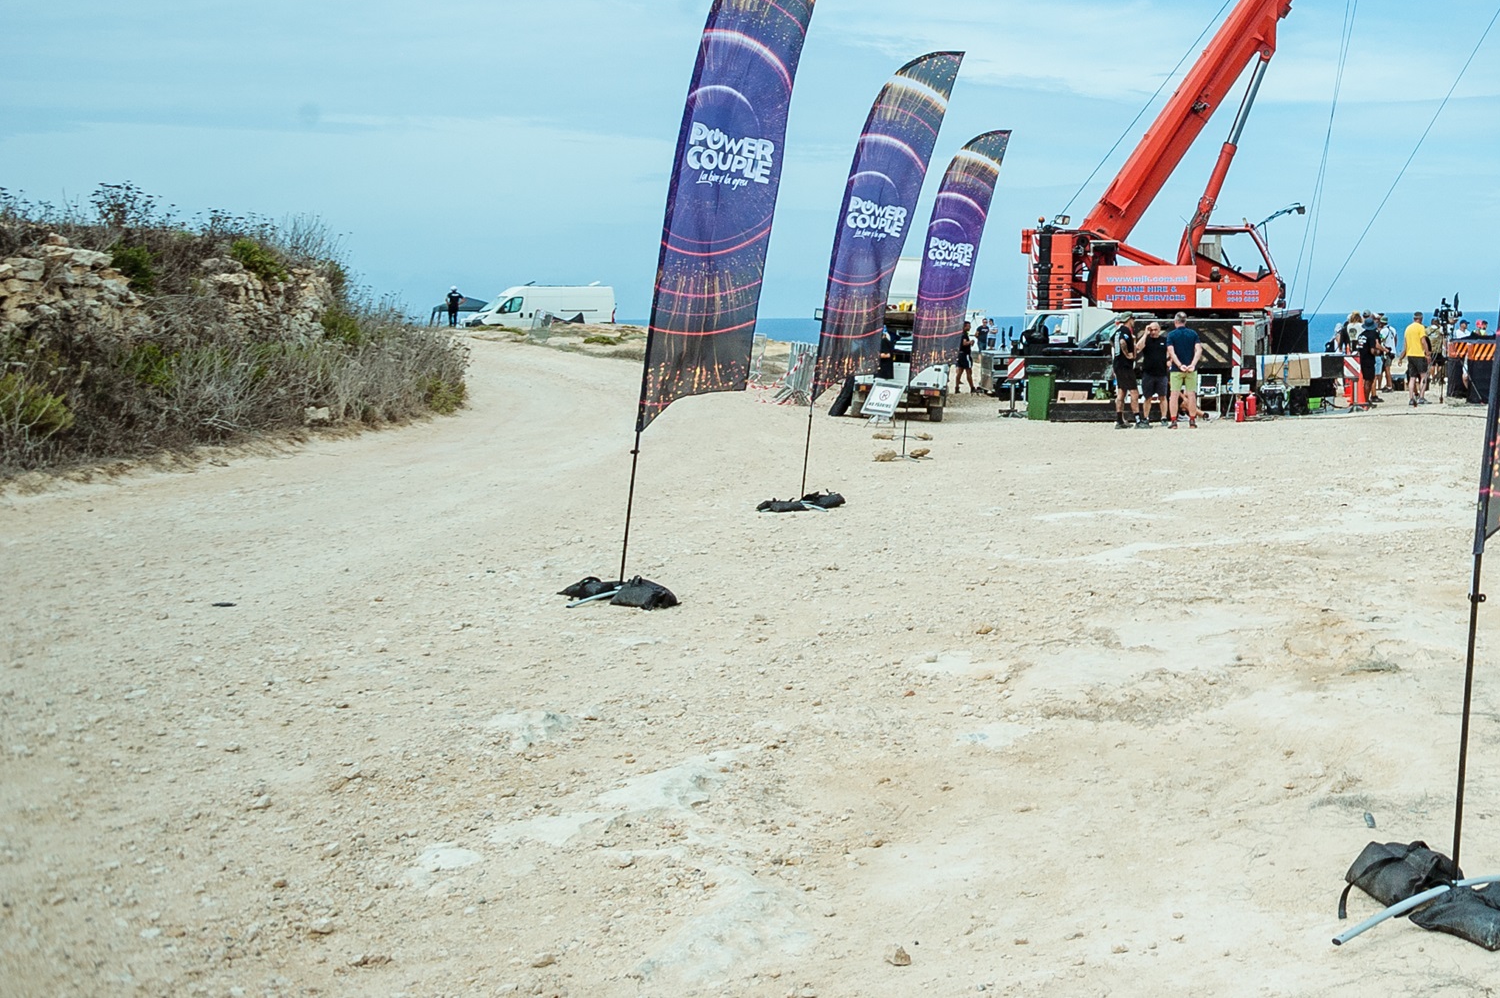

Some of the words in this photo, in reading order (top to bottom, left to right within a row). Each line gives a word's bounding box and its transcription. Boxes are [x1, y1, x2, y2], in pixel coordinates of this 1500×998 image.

[689, 121, 775, 162] POWER
[687, 145, 773, 184] COUPLE
[848, 196, 907, 224] POWER
[847, 212, 904, 238] COUPLE
[928, 248, 972, 267] COUPLE
[929, 236, 974, 255] POWER
